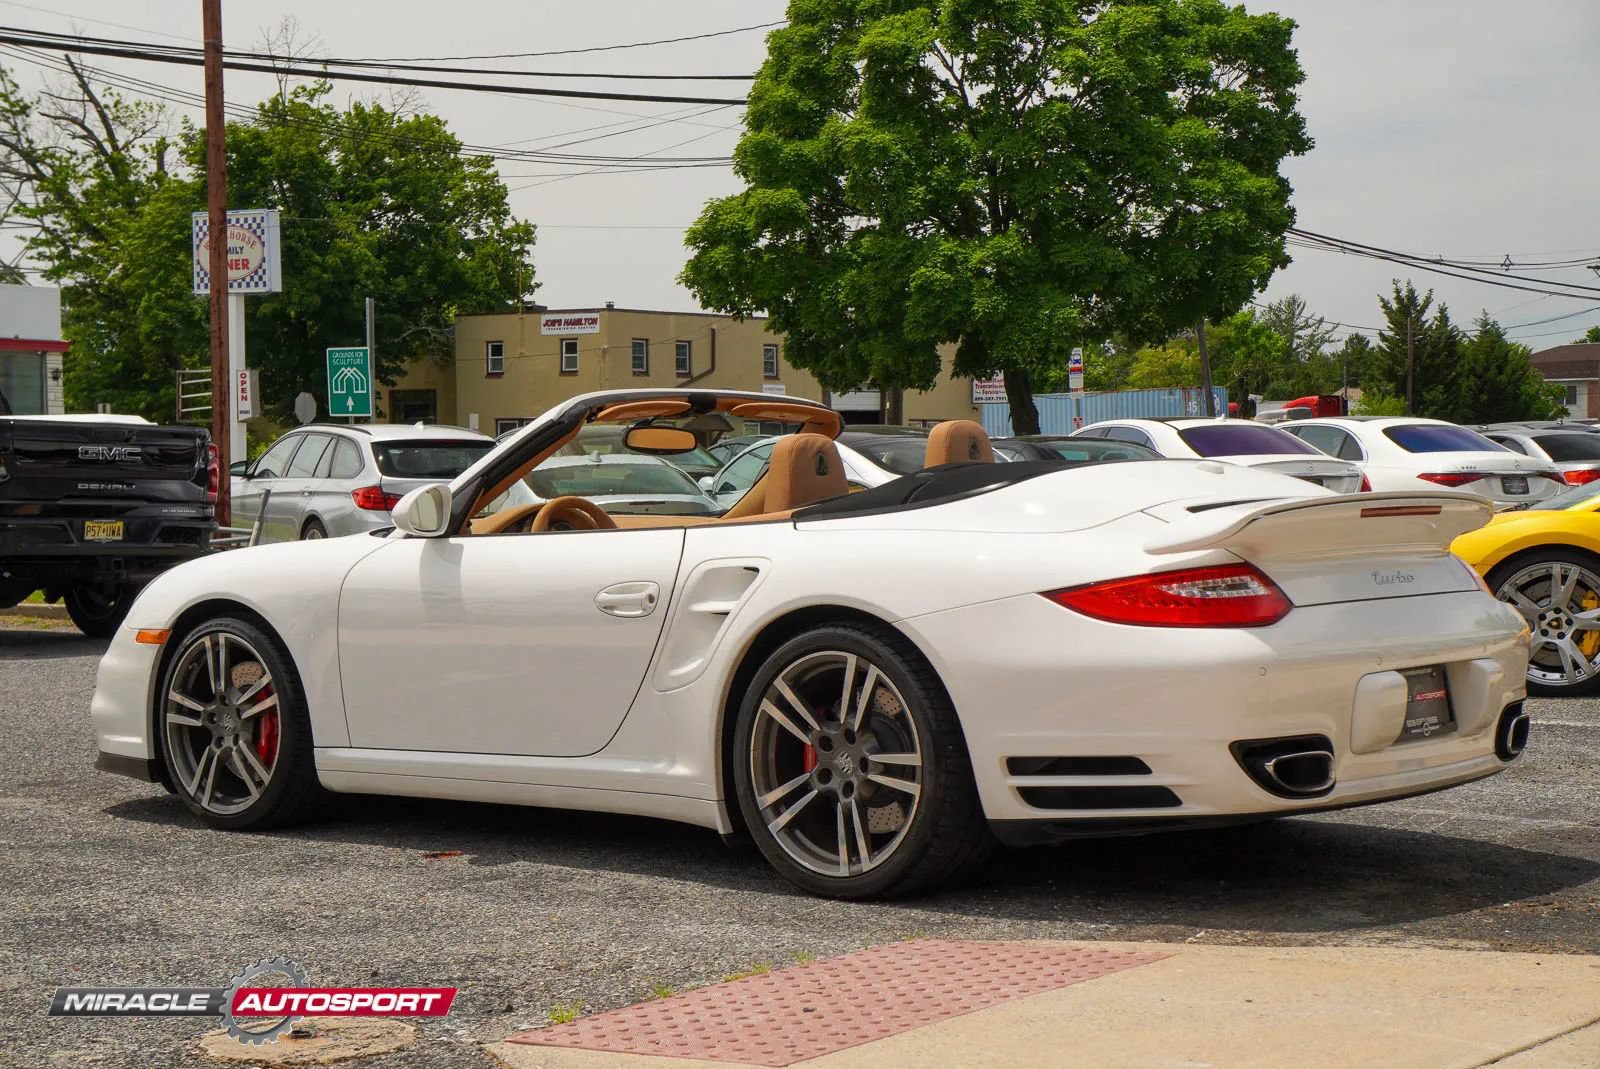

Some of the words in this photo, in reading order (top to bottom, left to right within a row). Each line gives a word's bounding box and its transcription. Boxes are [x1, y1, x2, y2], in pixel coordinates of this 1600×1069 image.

[229, 229, 257, 250] HORSE
[227, 258, 250, 270] NER
[563, 318, 598, 326] HAMILTON
[239, 372, 248, 402] OPEN
[78, 446, 141, 460] GMC
